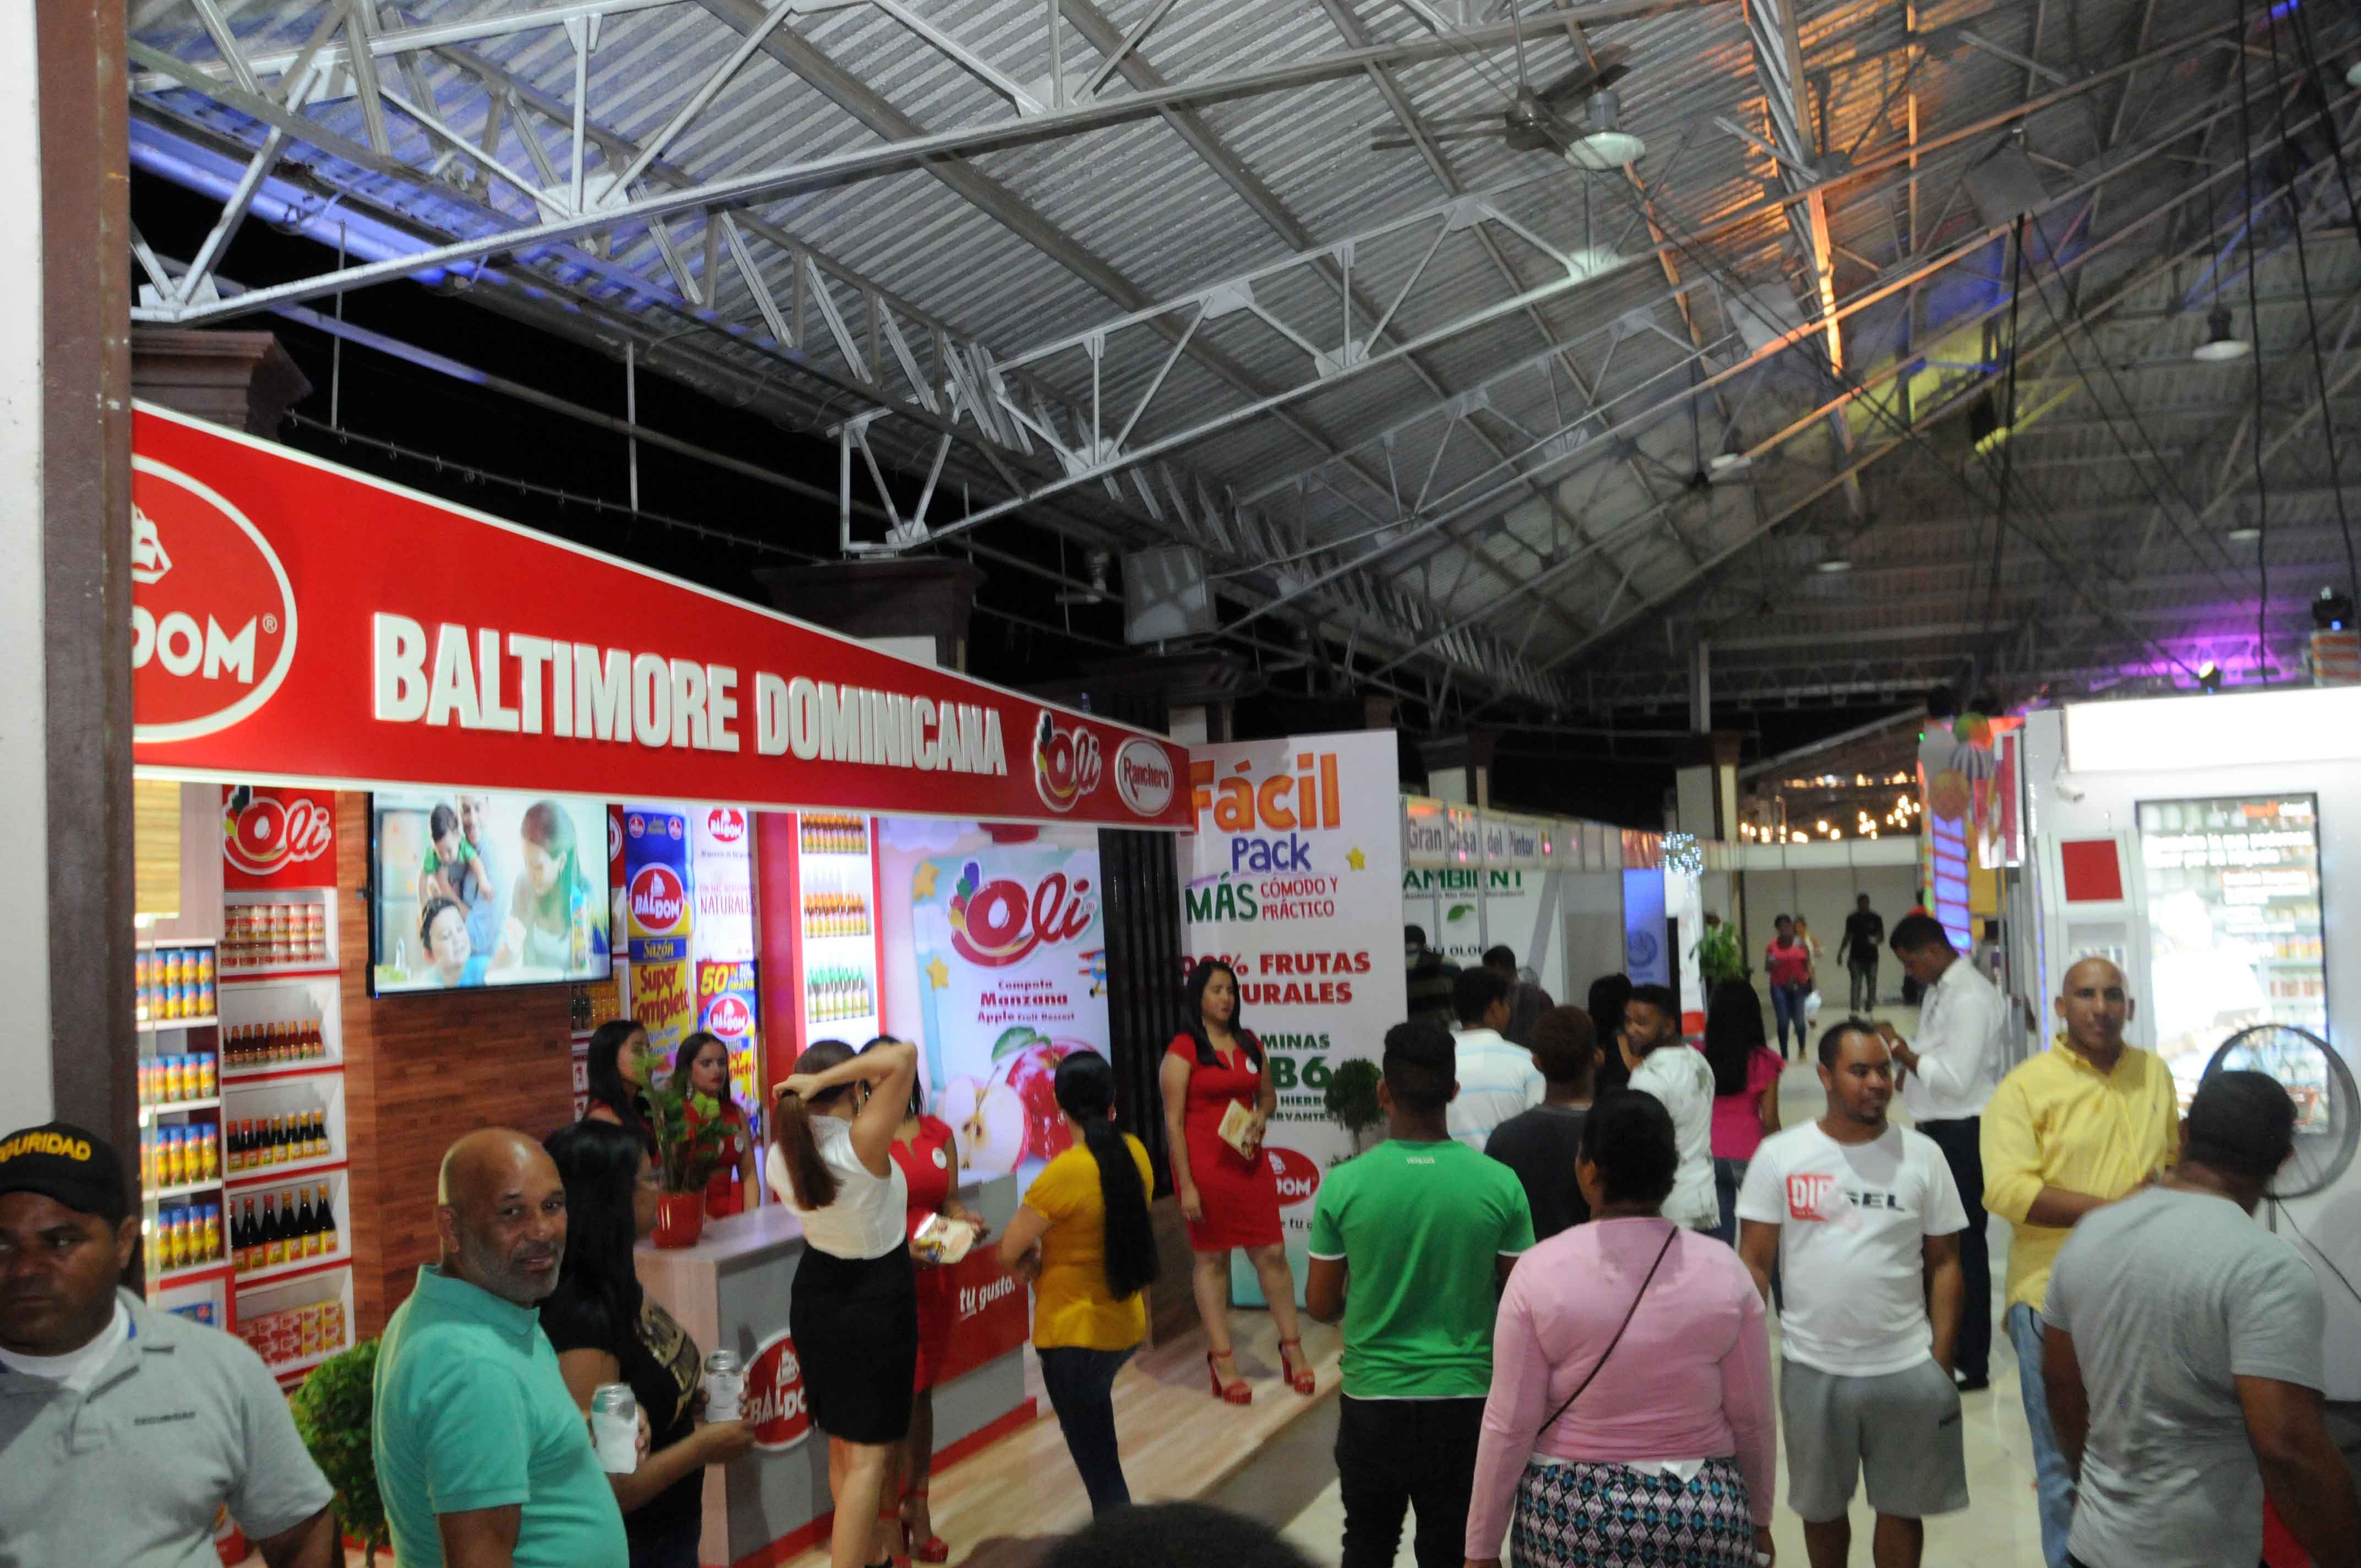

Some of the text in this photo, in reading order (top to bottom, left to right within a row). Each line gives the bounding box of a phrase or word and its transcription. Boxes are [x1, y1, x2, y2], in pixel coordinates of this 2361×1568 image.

[373, 612, 1007, 776] BALTIMORE DOMINICANA
[1046, 731, 1100, 791] Oli
[1123, 757, 1169, 802] Ranchero
[1180, 752, 1340, 835] Fácil
[237, 801, 330, 857] Oli
[1410, 818, 1441, 851] Gran
[1488, 828, 1503, 855] del
[1232, 833, 1312, 873] Pack
[634, 889, 681, 919] BALDOM
[1185, 872, 1258, 924] MÁS
[1260, 877, 1338, 899] CÓMODO Y
[965, 873, 1091, 948] Oli
[1262, 897, 1335, 921] PRÁCTICO
[644, 938, 674, 959] Sazón
[1260, 952, 1371, 976] FRUTAS
[640, 963, 678, 1000] Super
[981, 993, 1068, 1007] Manzana
[978, 1011, 1014, 1025] Apple
[1270, 1057, 1332, 1088] B6
[960, 1275, 1015, 1314] tu gusto.
